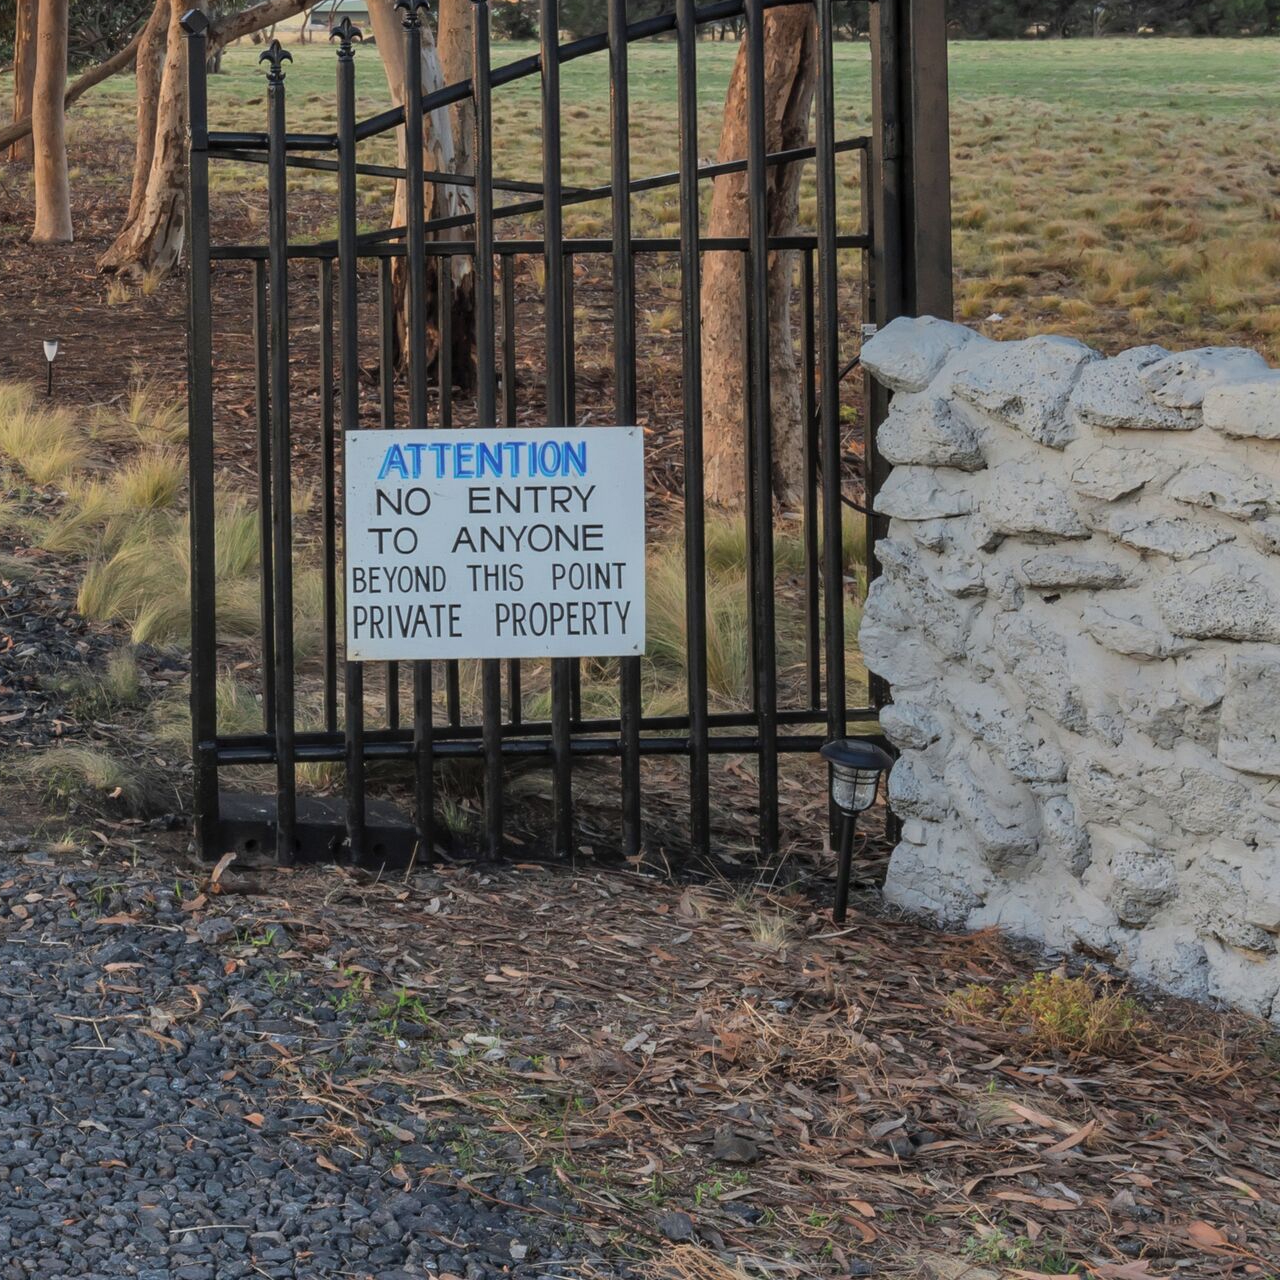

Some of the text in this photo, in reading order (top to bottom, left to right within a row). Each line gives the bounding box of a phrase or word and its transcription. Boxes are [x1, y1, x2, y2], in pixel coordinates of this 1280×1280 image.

[377, 441, 586, 479] ATTENTION
[376, 485, 595, 516] NO ENTRY
[368, 525, 603, 554] TO ANYONE
[353, 563, 626, 593] BEYOND THIS POINT
[353, 601, 630, 639] PRIVATE PROPERTY
